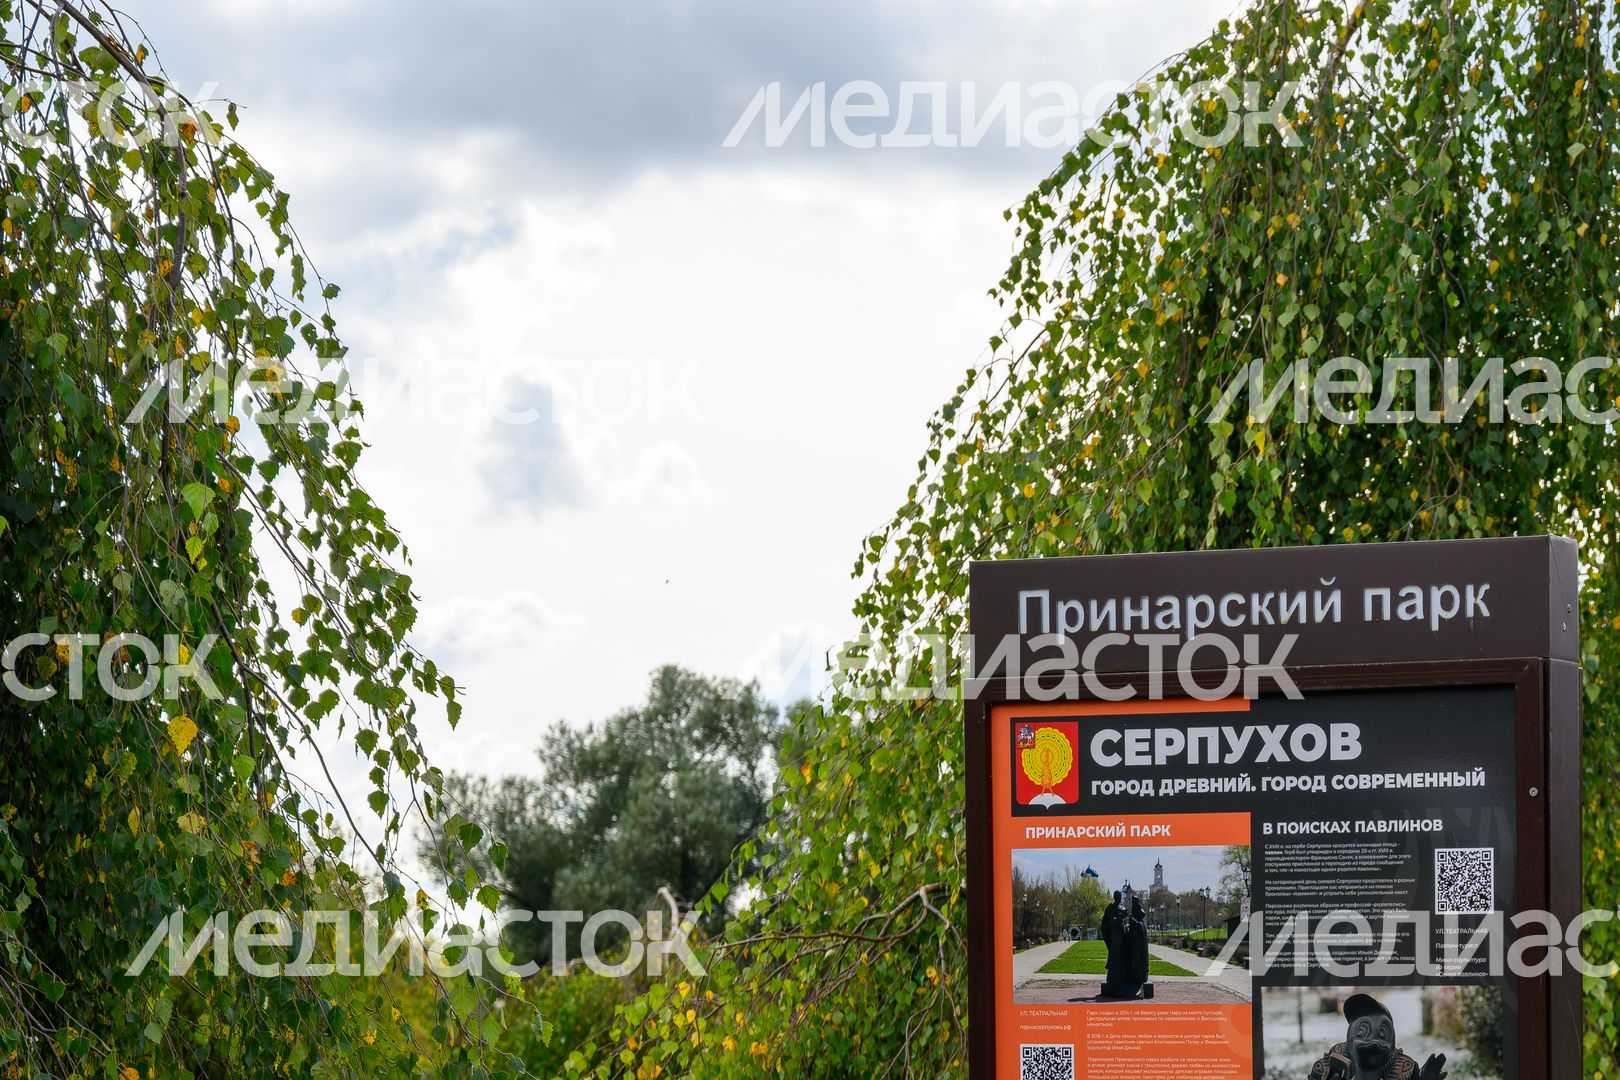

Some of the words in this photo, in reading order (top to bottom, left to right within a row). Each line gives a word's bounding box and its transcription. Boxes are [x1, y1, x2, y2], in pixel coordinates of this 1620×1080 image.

[1018, 576, 1341, 645] Принарский
[1363, 583, 1490, 631] парк
[1090, 723, 1362, 767] СЕРПУХОВ
[1092, 779, 1154, 796] ГОРОД
[1159, 773, 1256, 796] ДРЕВНИЙ.
[1262, 775, 1326, 792] ГОРОД
[1331, 767, 1486, 790] СОВРЕМЕННЫЙ
[1026, 822, 1126, 838] ПРИНАРСКИЙ
[1130, 824, 1171, 837] ПАРК
[1263, 822, 1272, 834] В
[1277, 821, 1350, 834] ПОИСКАХ
[1355, 819, 1443, 833] ПАВЛИНОВ
